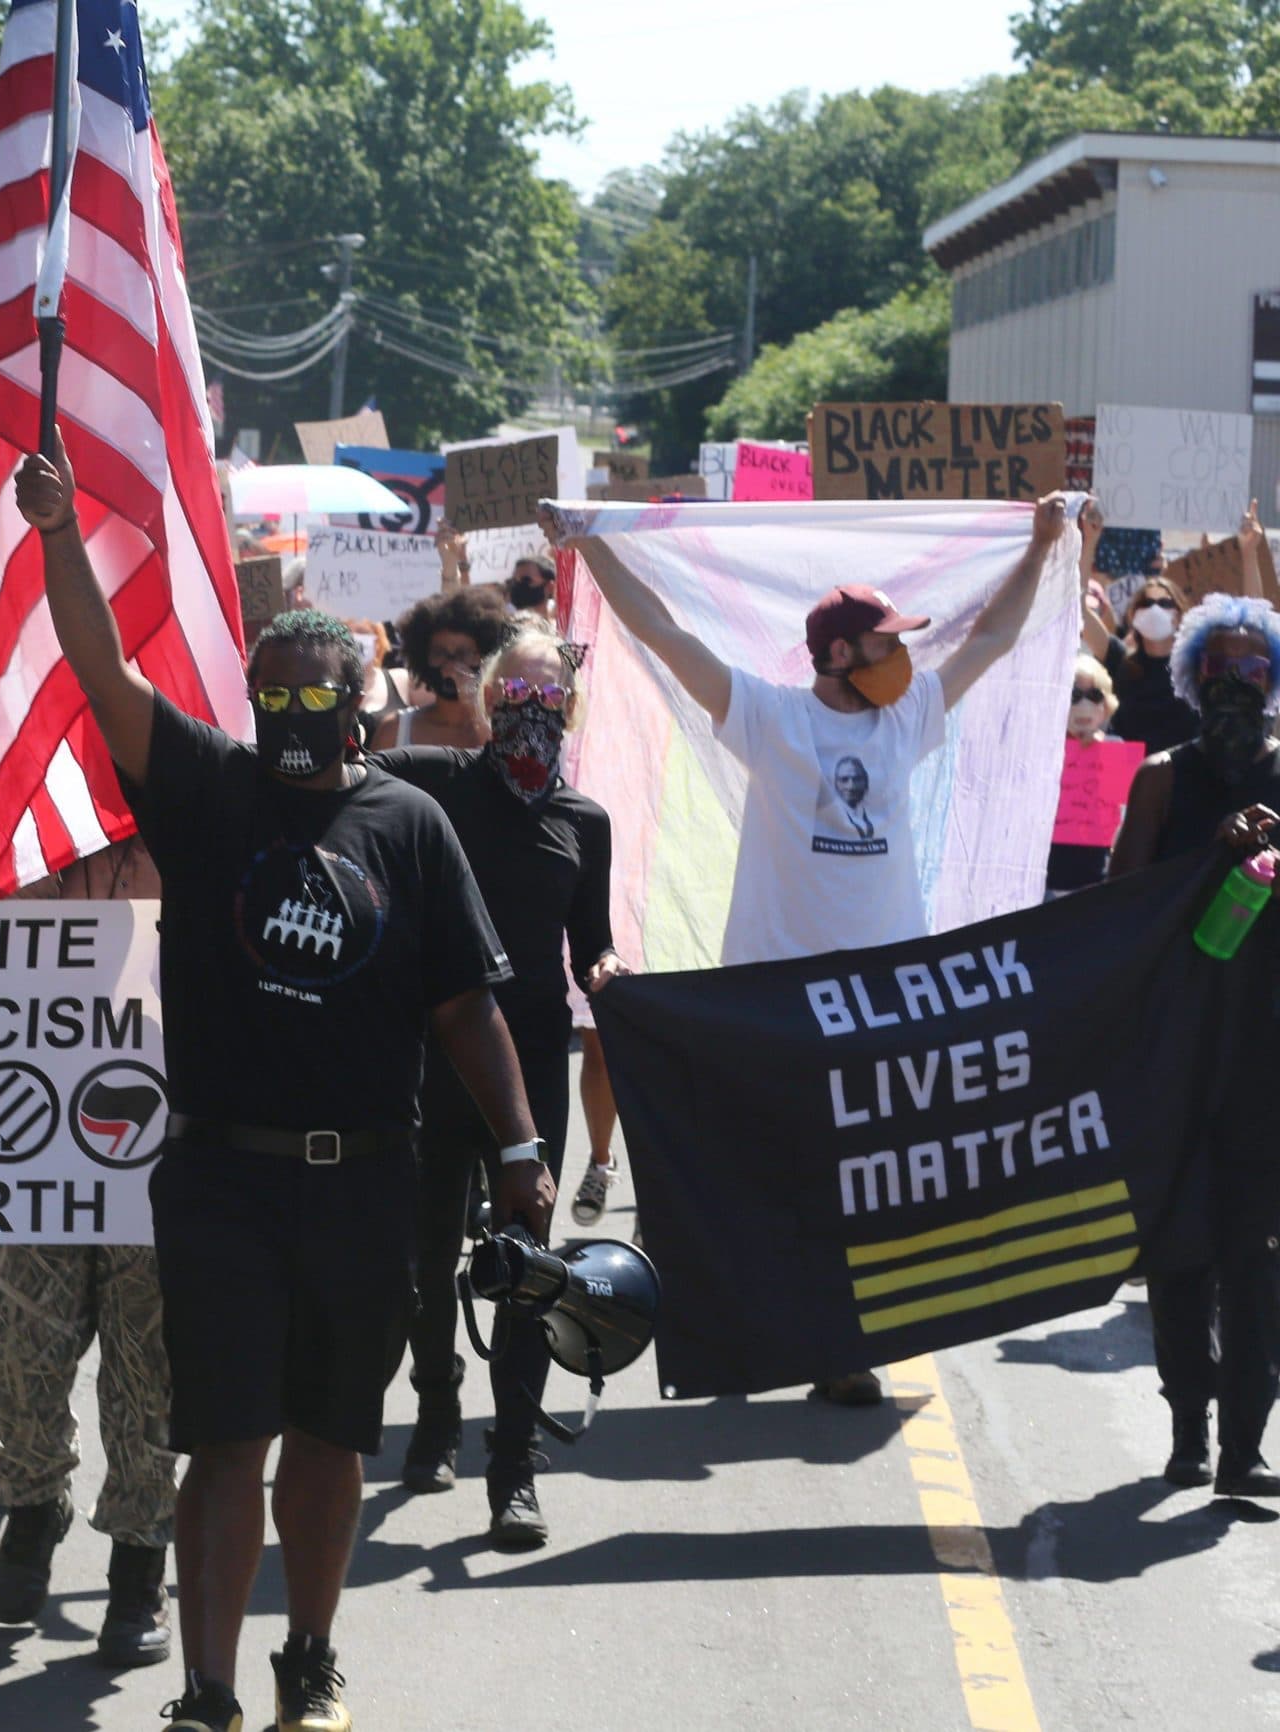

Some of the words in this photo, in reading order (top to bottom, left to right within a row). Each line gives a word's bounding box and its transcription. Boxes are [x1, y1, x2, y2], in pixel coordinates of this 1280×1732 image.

[824, 406, 936, 475] BLACK
[948, 405, 1053, 459] LIVES
[1097, 404, 1134, 439] NO
[459, 441, 549, 479] BLACK
[739, 443, 792, 473] BLACK
[1096, 442, 1135, 477] NO
[463, 464, 549, 498] LIVES
[862, 454, 1035, 501] MATTER
[1096, 482, 1136, 521] NO
[264, 981, 284, 994] LIFT
[284, 986, 298, 998] MY
[805, 939, 1035, 1038] BLACK
[828, 1030, 1031, 1129] LIVES
[839, 1090, 1110, 1216] MATTER
